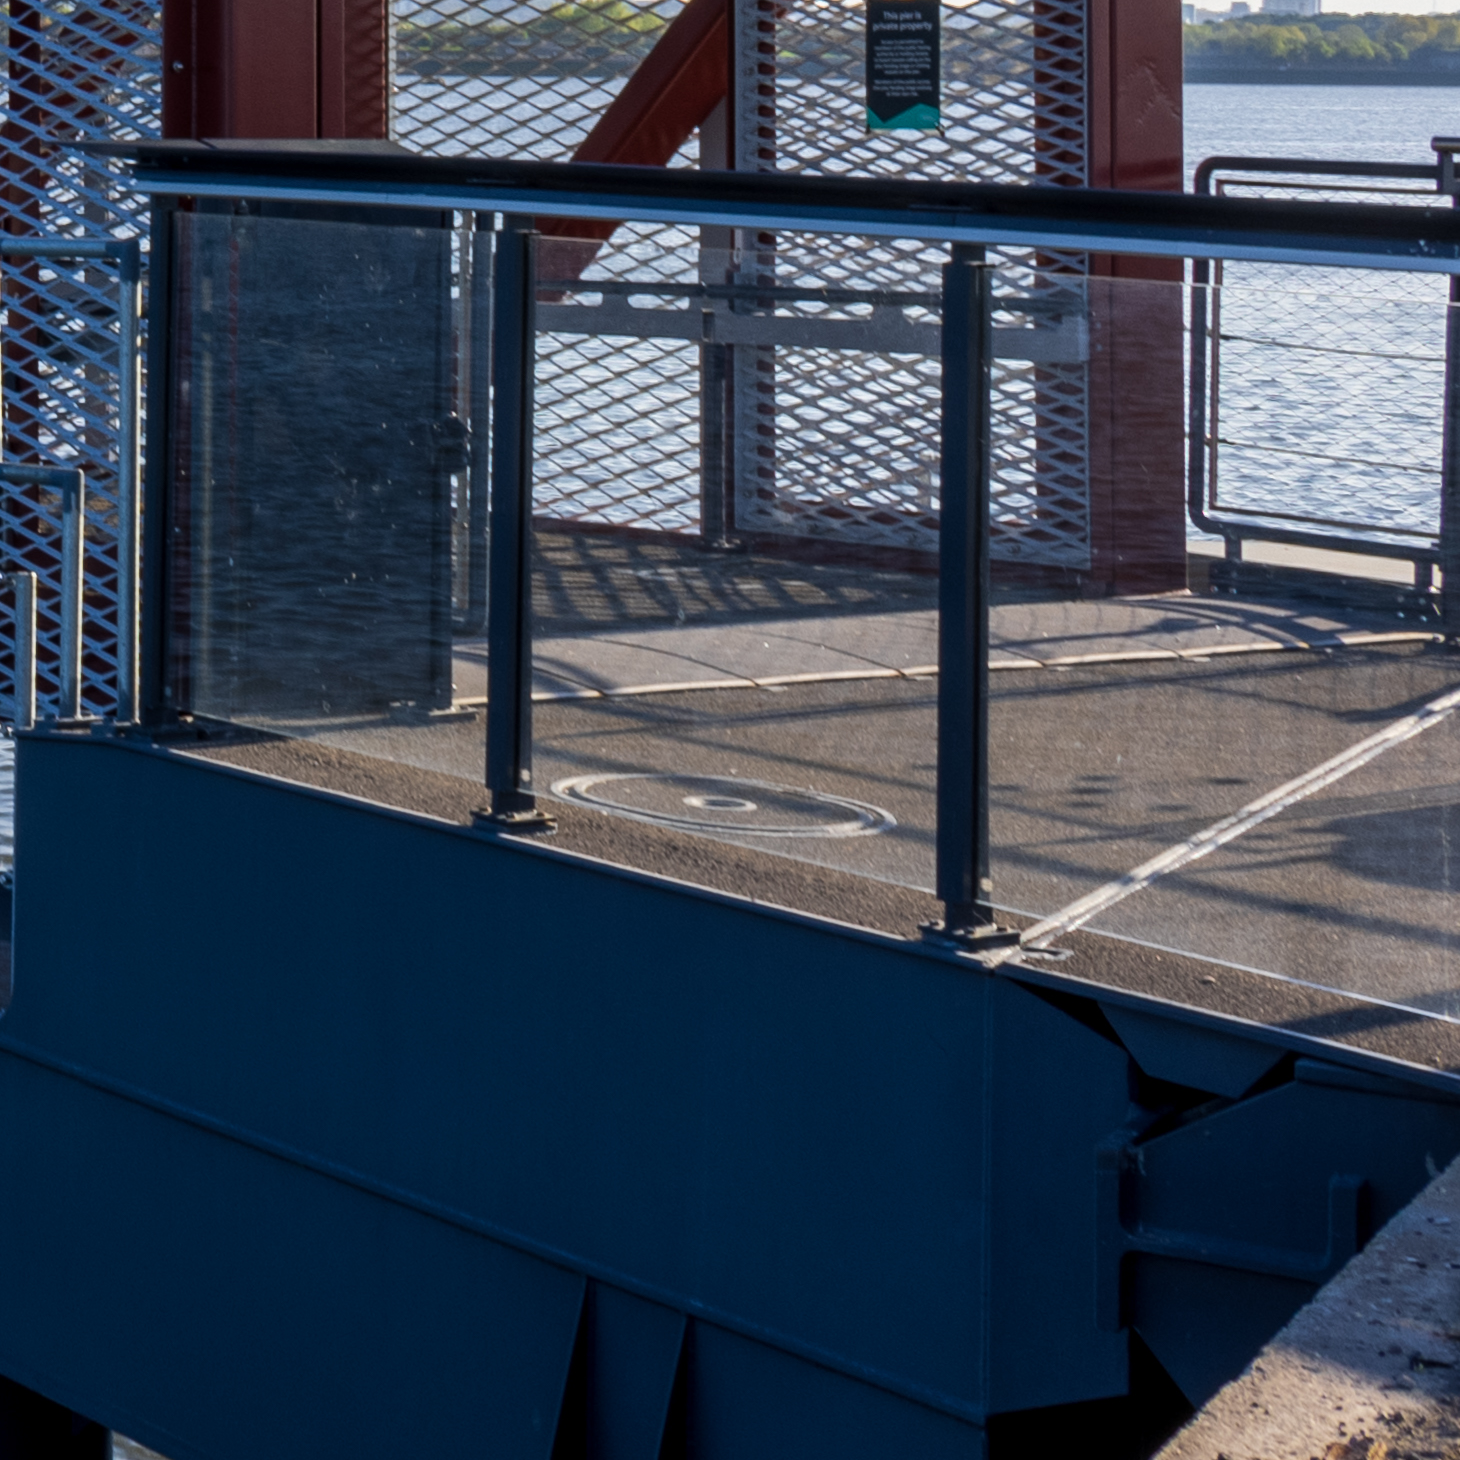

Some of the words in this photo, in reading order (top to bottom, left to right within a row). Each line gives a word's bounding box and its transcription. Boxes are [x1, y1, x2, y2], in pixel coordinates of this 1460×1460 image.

[883, 10, 898, 20] This
[899, 11, 913, 21] pier
[914, 11, 922, 20] is
[872, 22, 898, 32] private
[899, 22, 933, 32] property
